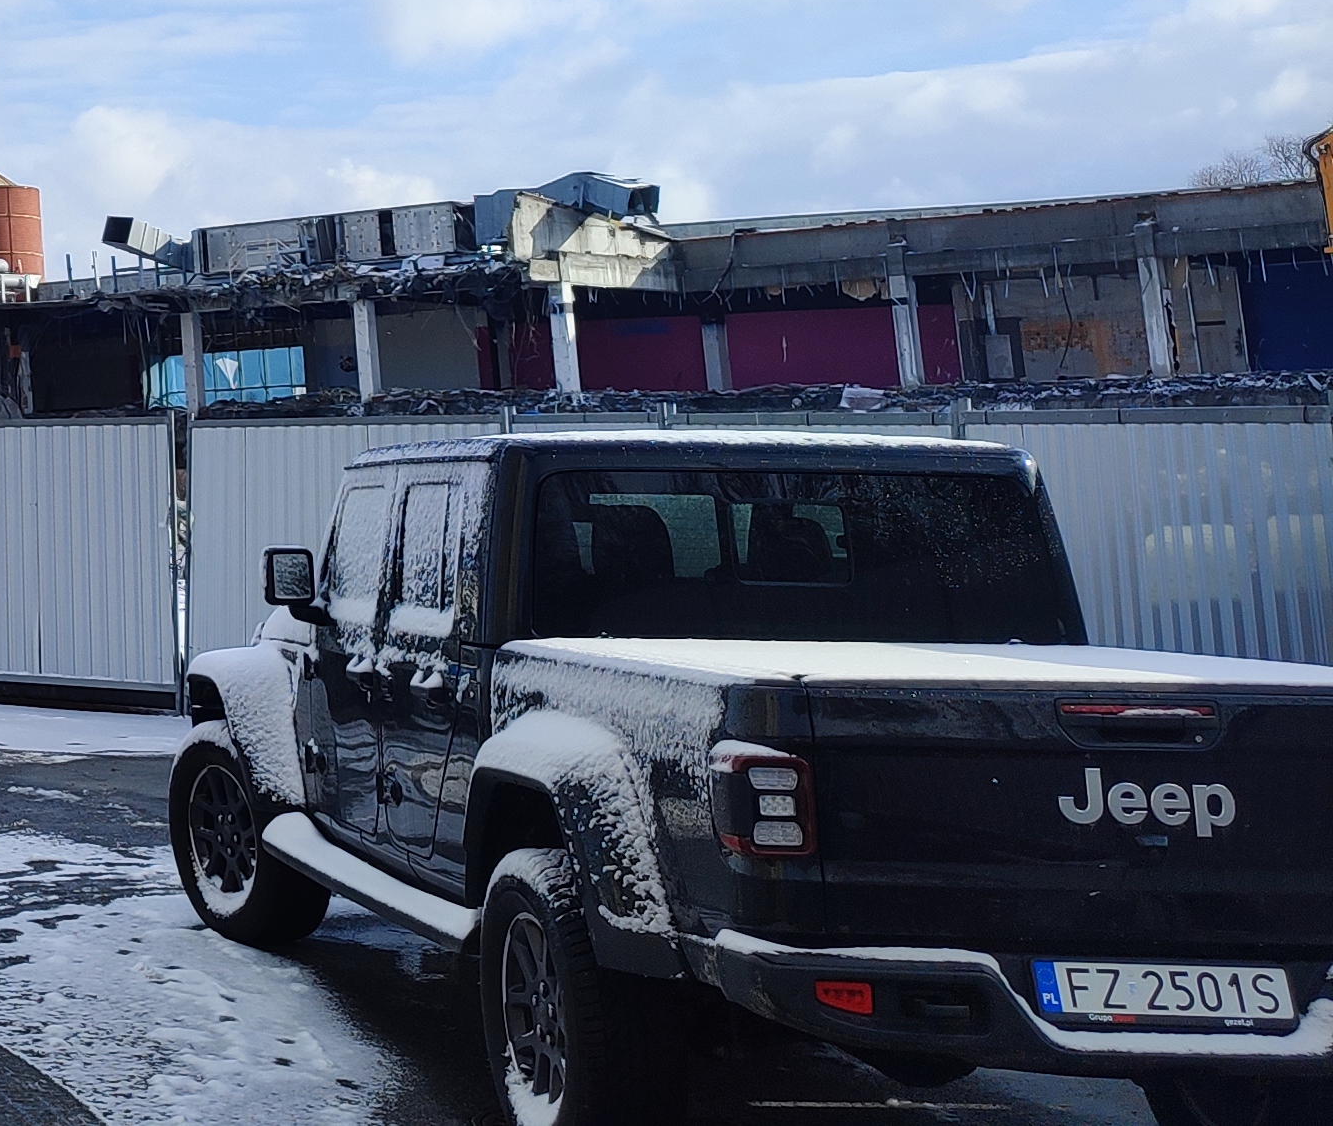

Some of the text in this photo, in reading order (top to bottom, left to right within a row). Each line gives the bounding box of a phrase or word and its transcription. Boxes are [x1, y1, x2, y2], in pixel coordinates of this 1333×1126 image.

[1058, 767, 1236, 838] Jeep
[1042, 992, 1060, 1005] PL
[1065, 967, 1280, 1014] FZ 2501S
